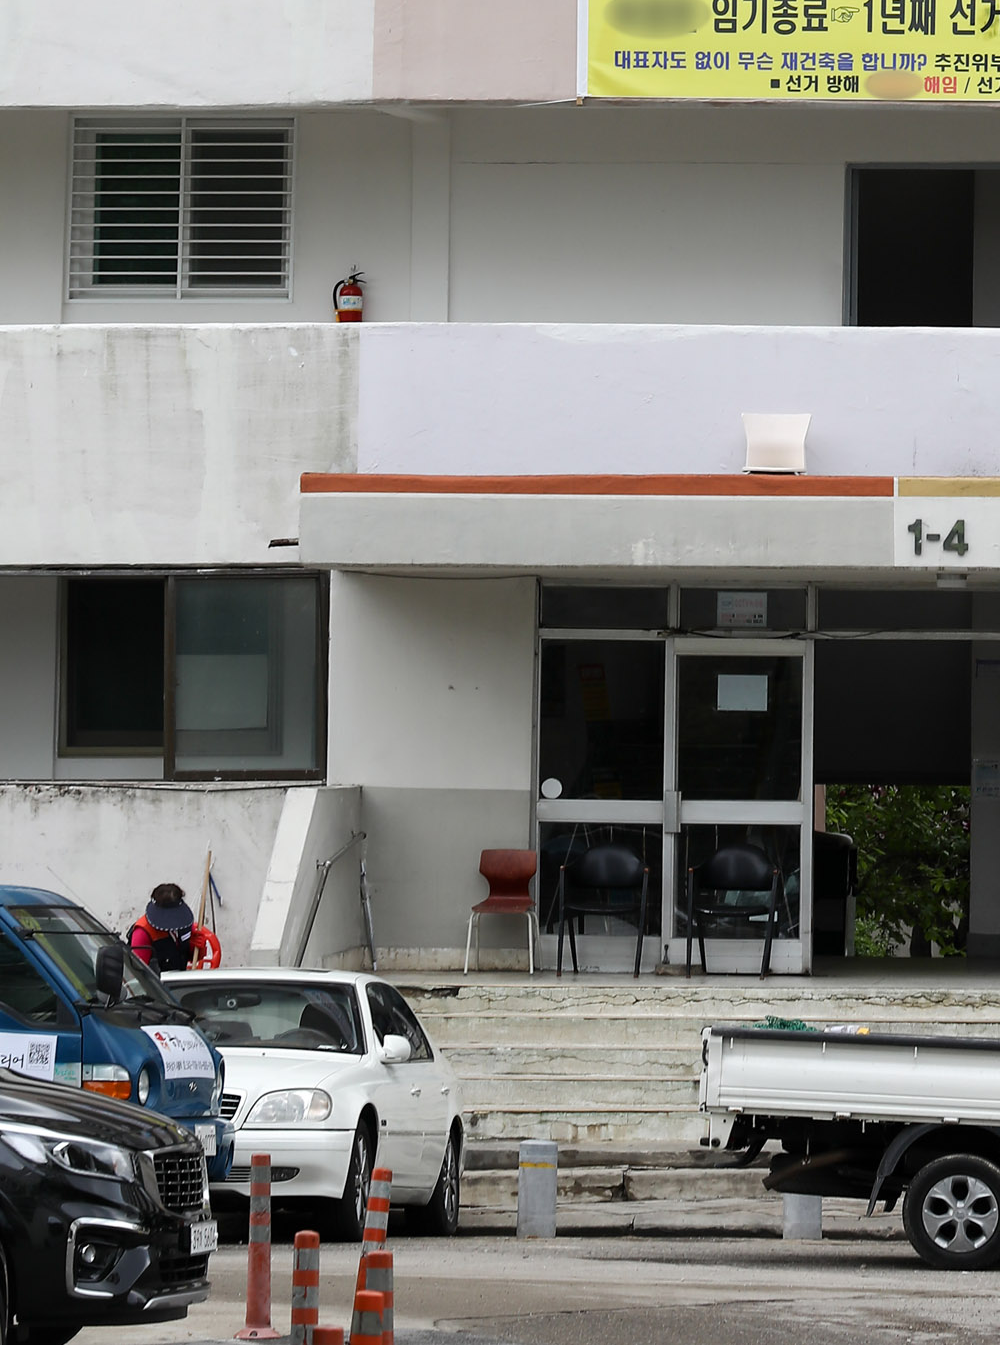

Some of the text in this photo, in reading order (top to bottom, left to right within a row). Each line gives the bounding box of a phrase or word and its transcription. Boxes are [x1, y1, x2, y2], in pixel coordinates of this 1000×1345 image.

[615, 51, 686, 69] 대표자도
[695, 52, 729, 70] 없이
[738, 52, 773, 70] 무슨
[781, 52, 853, 71] 재건축을
[862, 53, 927, 71] 합니까?
[786, 75, 818, 92] 선거
[827, 76, 859, 93] 방해
[924, 76, 957, 93] 해임
[908, 519, 968, 557] 1-4
